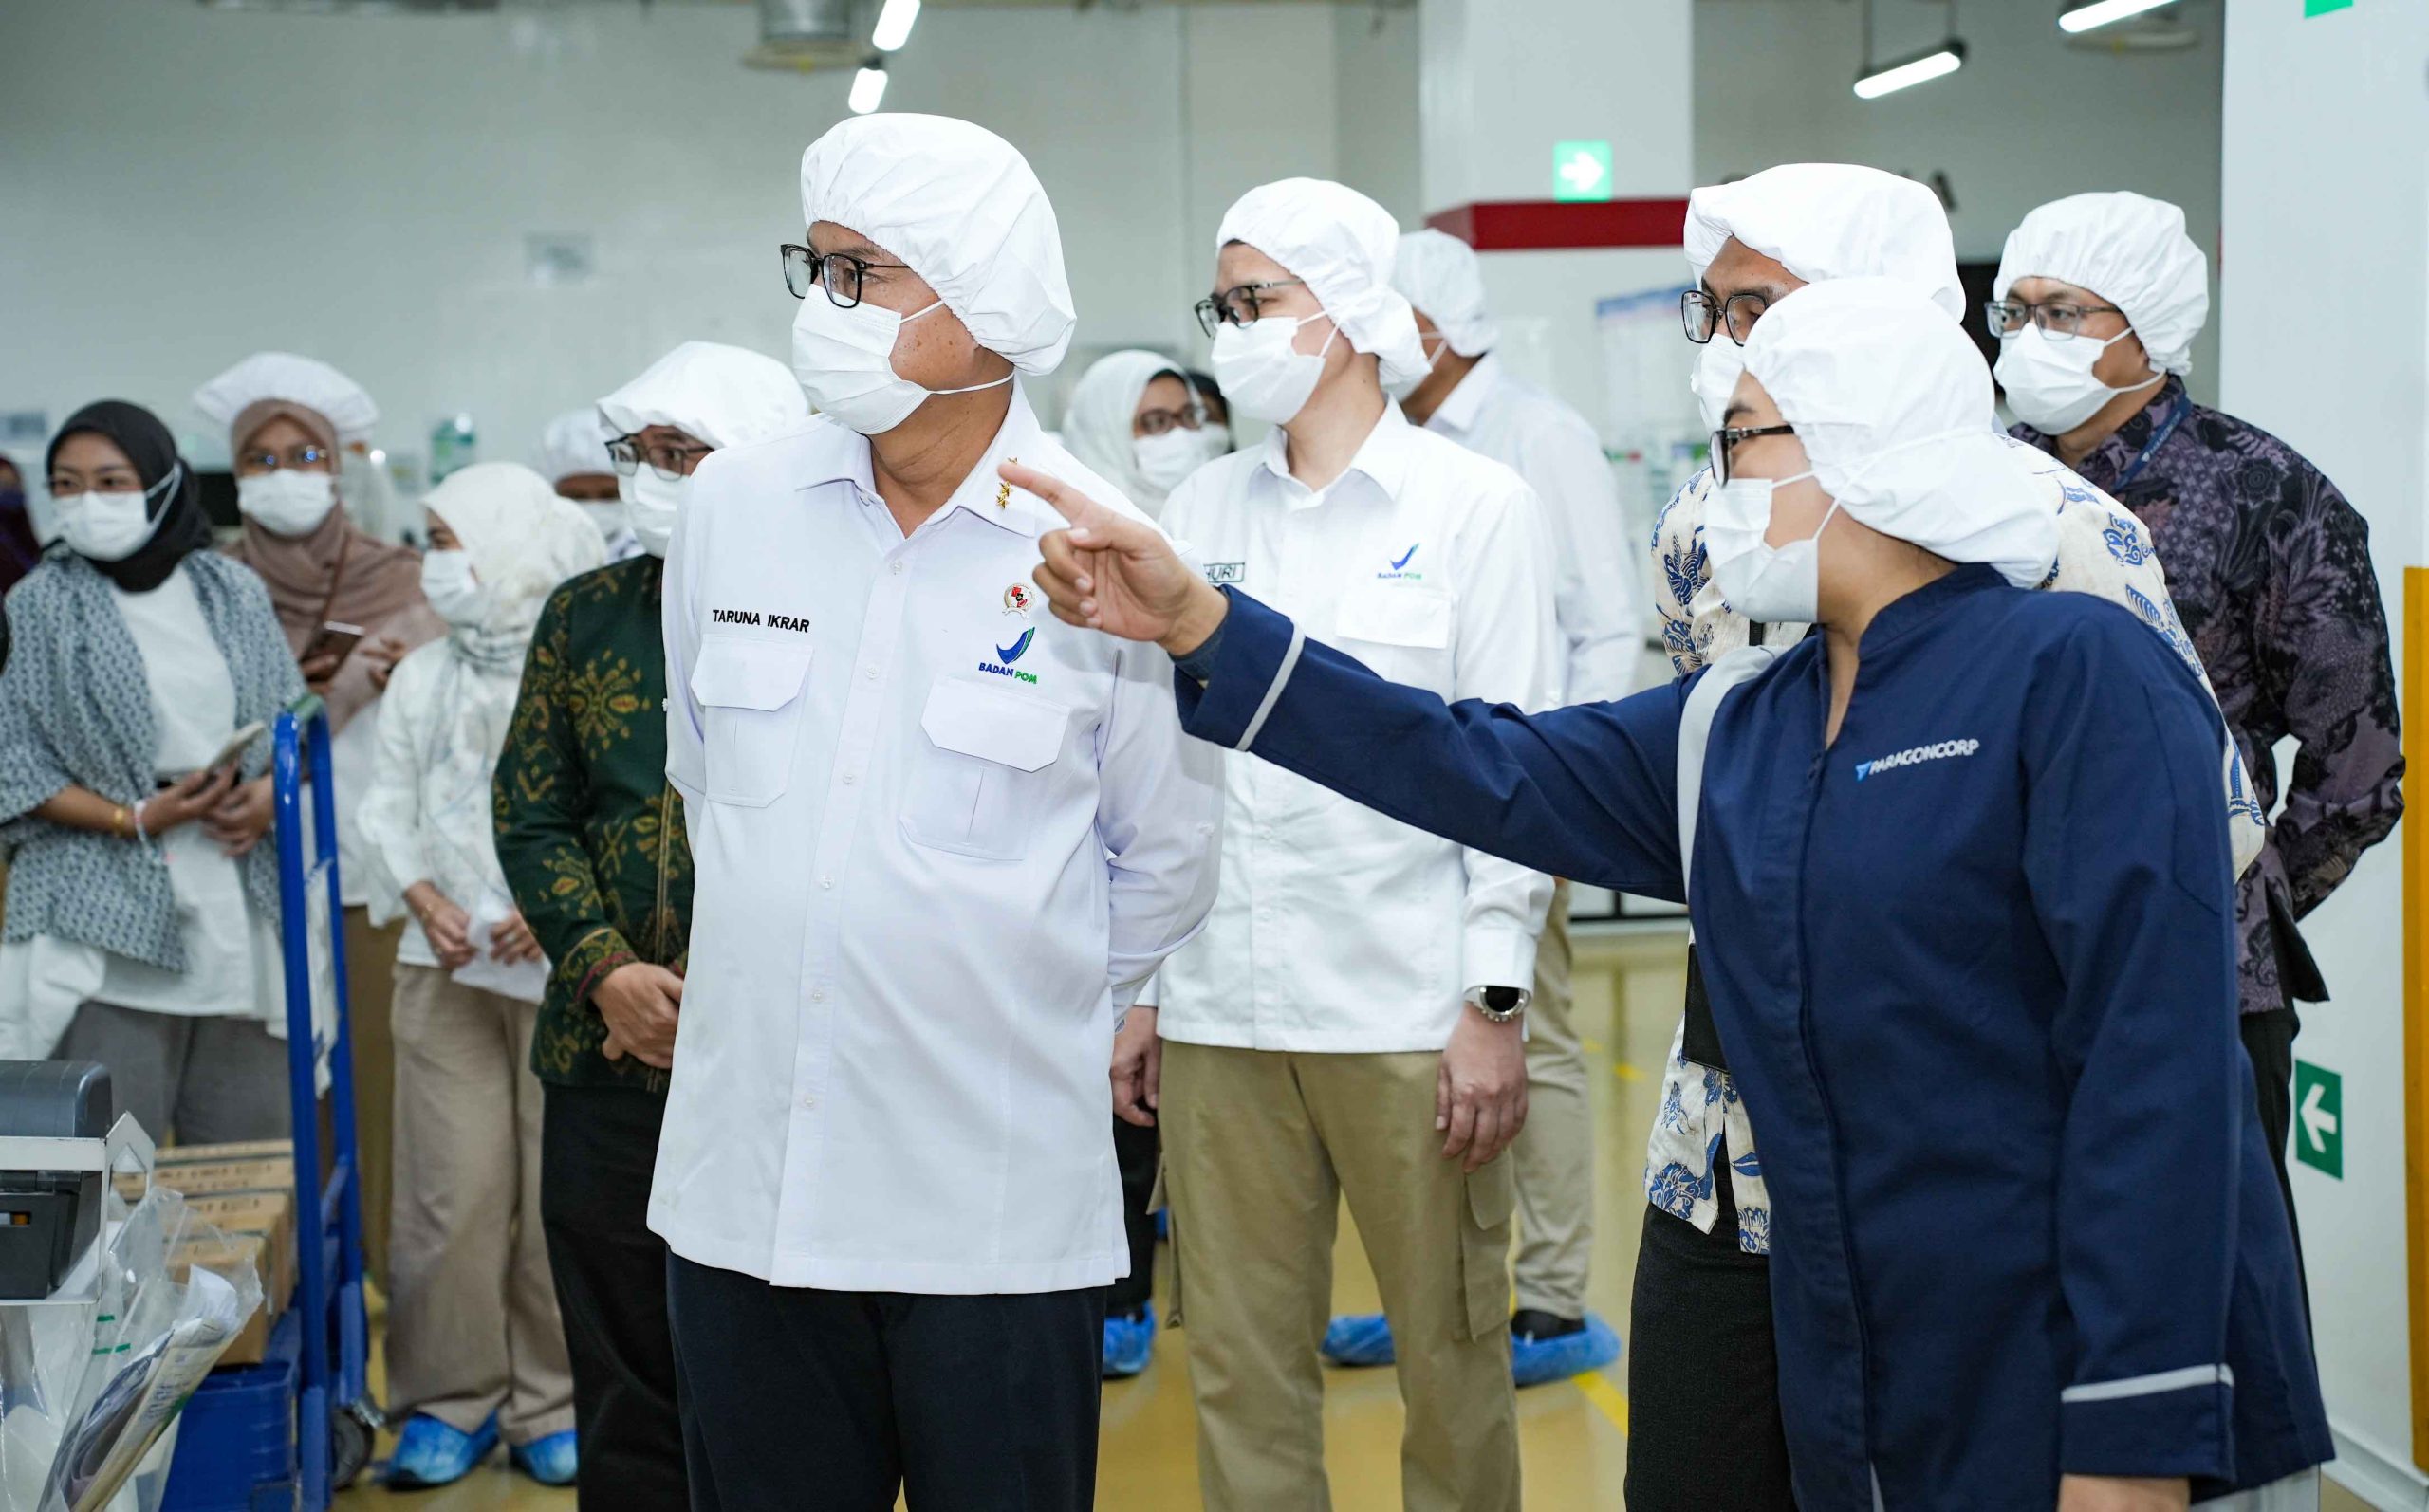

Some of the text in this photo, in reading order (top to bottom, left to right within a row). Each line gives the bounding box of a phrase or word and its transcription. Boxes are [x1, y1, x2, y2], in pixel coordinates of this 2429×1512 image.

[713, 609, 810, 633] TARUNA IKRAR
[978, 662, 1038, 684] BADAN POM
[1869, 738, 1980, 776] PARAGONCORP
